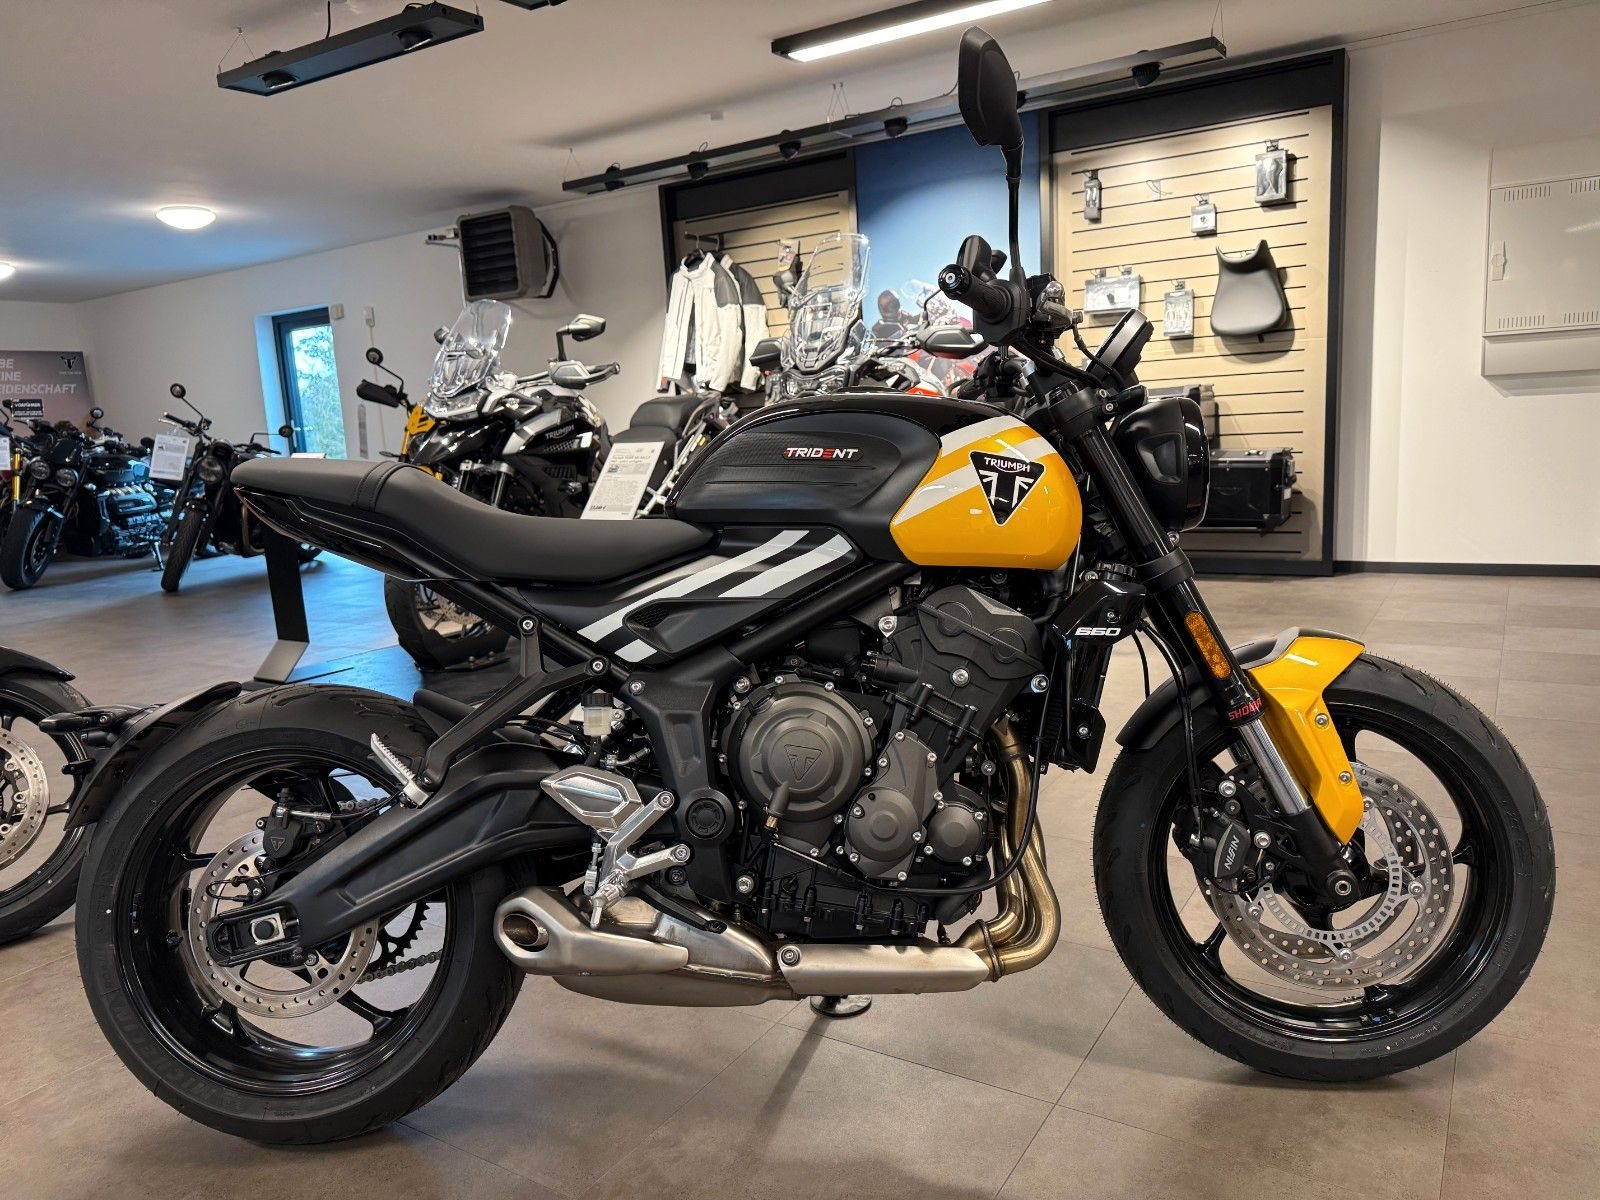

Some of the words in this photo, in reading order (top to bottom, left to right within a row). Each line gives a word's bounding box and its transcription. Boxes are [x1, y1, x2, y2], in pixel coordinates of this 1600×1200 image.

[0, 371, 21, 381] INE
[0, 384, 77, 394] IDENSCHAFT
[784, 447, 859, 459] TRIDENT
[984, 457, 1031, 473] TRIUMPH
[1074, 626, 1121, 636] 660
[1223, 834, 1240, 870] NISSIN
